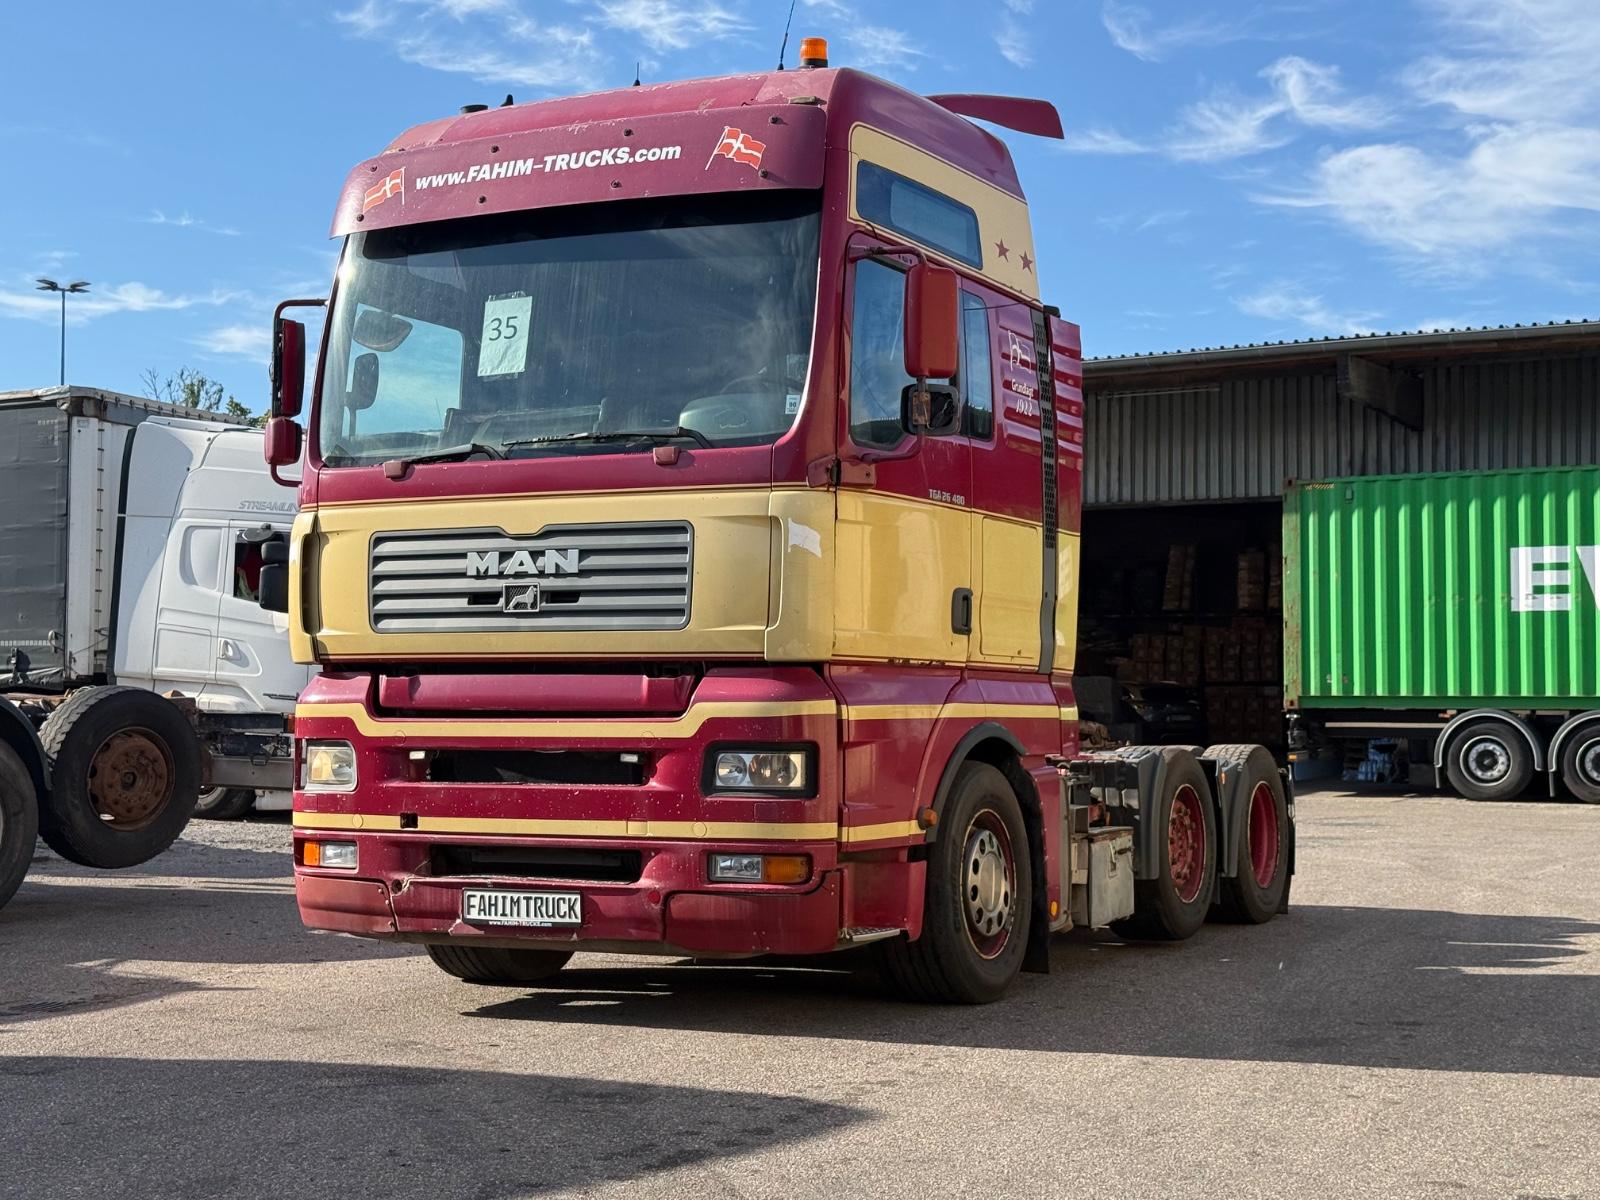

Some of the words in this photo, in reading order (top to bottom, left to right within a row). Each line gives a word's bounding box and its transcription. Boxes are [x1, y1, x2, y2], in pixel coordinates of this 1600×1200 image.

[415, 145, 682, 190] www.FAHIM-TRUCKS.com
[489, 316, 518, 341] 35
[928, 488, 941, 500] TGA
[942, 491, 951, 502] 26
[952, 494, 965, 506] 480
[466, 548, 579, 576] MAN
[466, 894, 579, 919] FAHIMTRUCK
